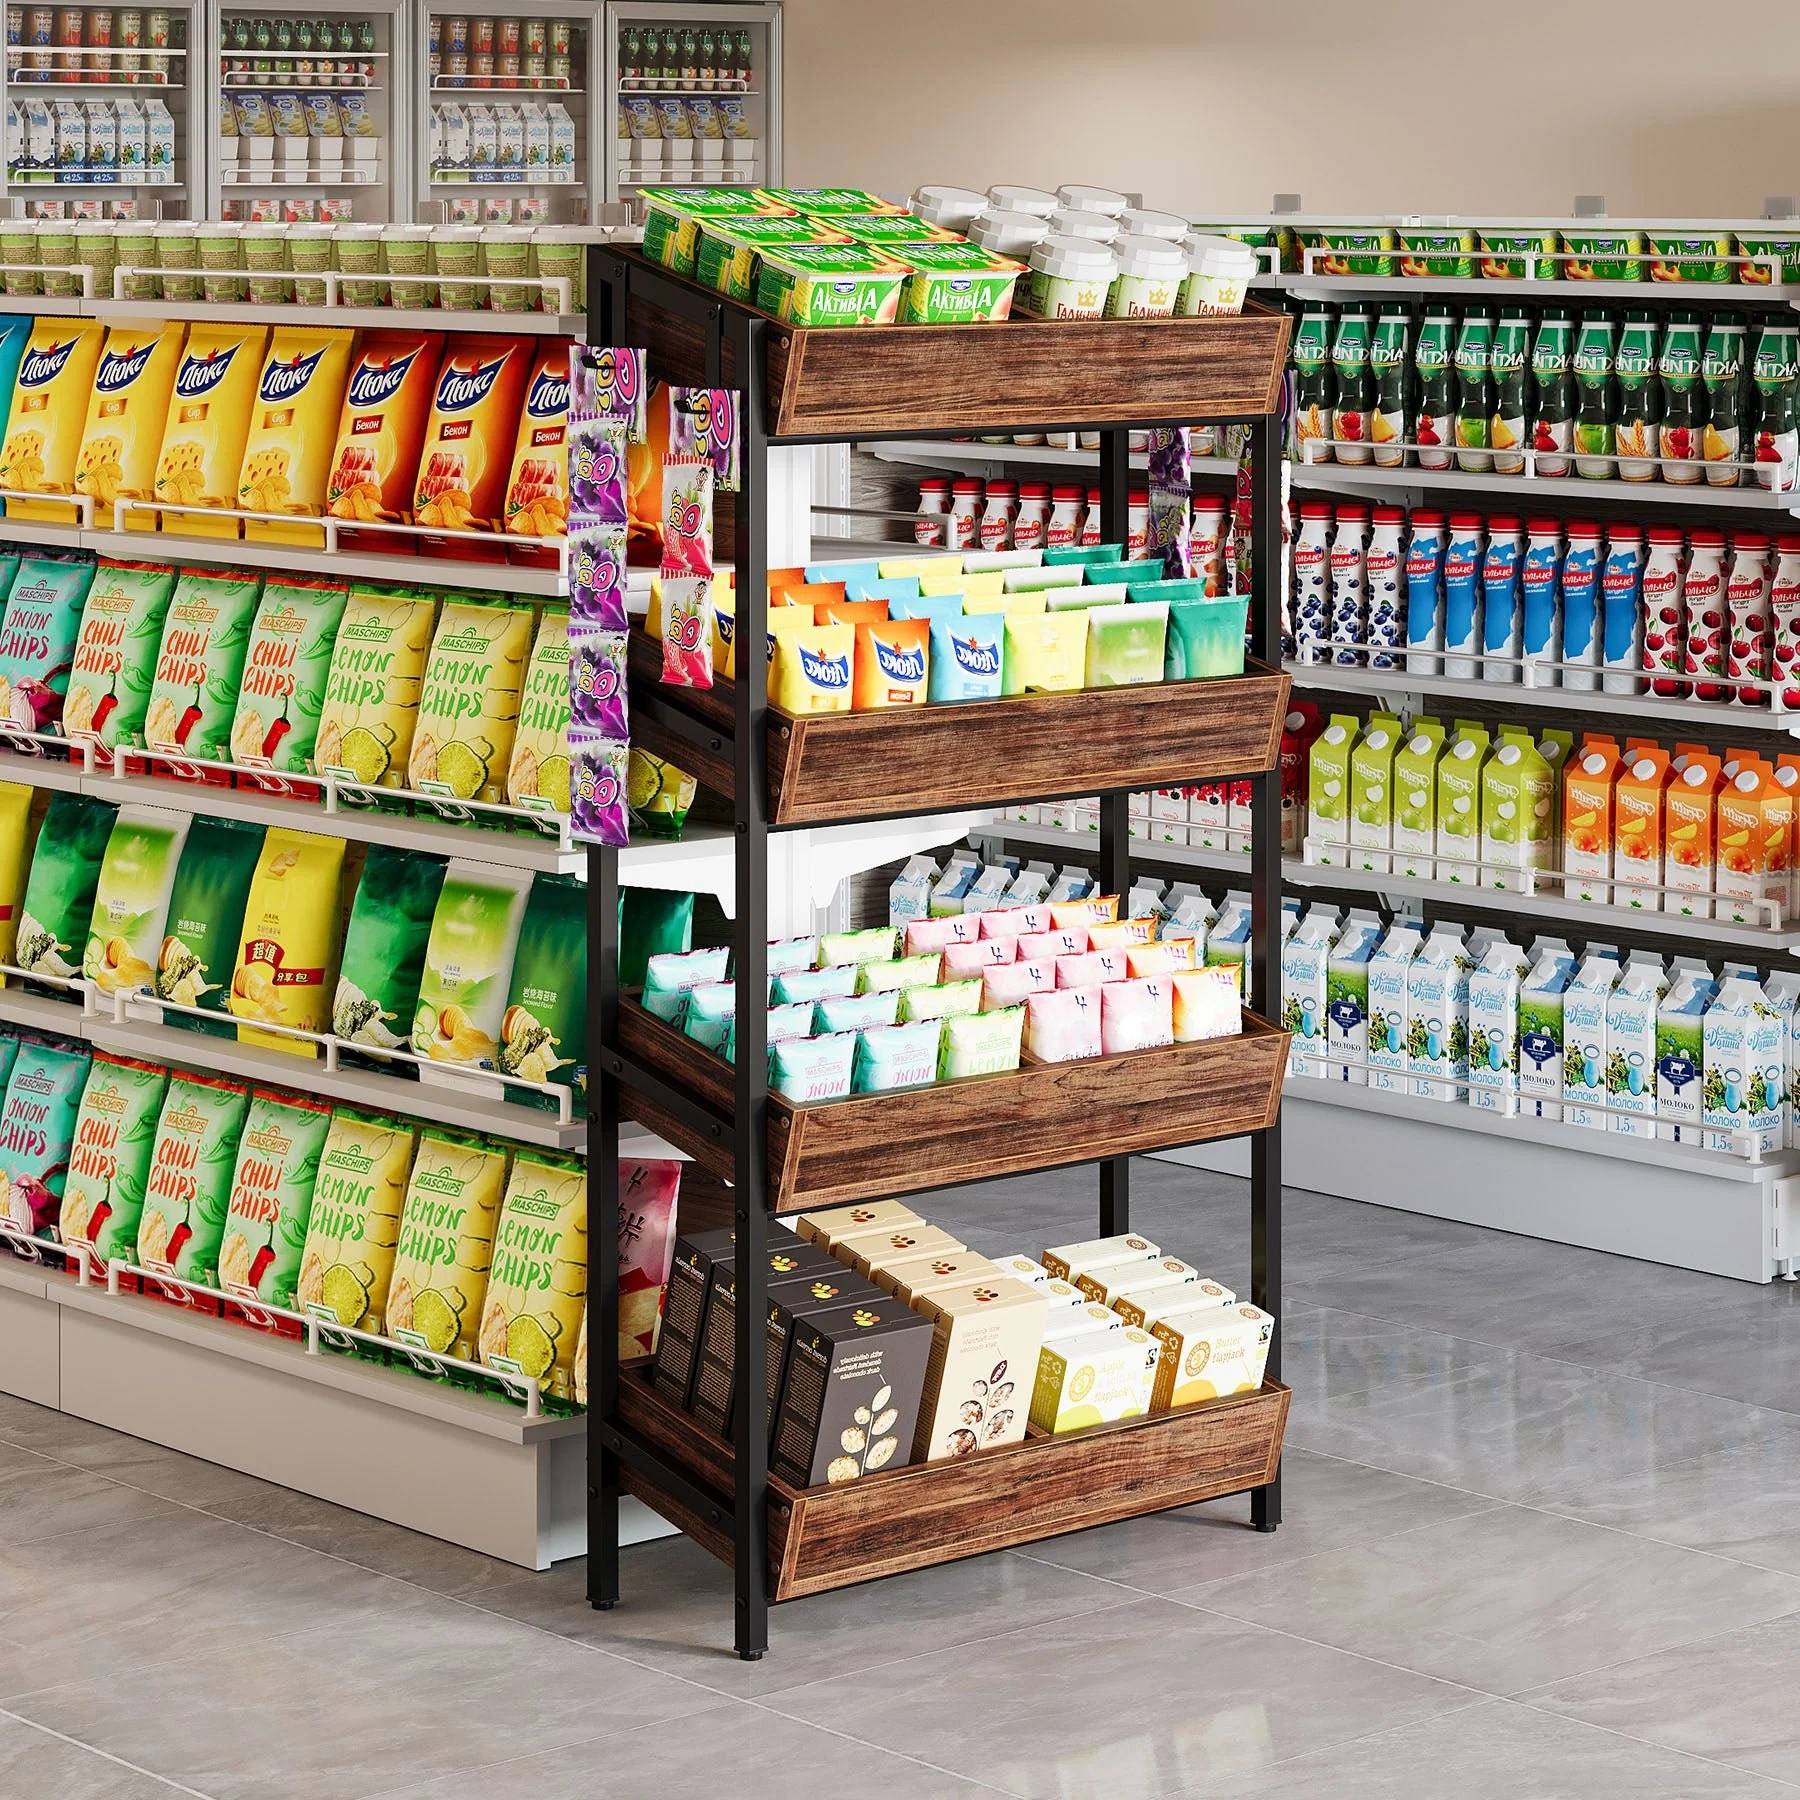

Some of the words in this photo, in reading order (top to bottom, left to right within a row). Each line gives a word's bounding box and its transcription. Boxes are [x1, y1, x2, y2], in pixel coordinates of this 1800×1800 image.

[529, 379, 570, 411] Люк
[355, 419, 379, 431] Бекон
[443, 425, 469, 437] Бекон
[535, 430, 561, 443] Бекон
[18, 589, 55, 601] MASCHIPS
[92, 598, 132, 612] MASCHIPS
[175, 608, 216, 621] MASCHIPS
[263, 617, 304, 631] MASCHIPS
[346, 627, 390, 640] MASCHIPS
[441, 638, 487, 651] MASCHIPS
[527, 669, 569, 697] LEMO
[521, 697, 571, 733] CHIP
[252, 942, 277, 963] 超值
[277, 972, 309, 982] 分享包
[1291, 1040, 1315, 1052] ОЛОКО
[1330, 1040, 1361, 1051] МОЛОКО
[894, 1050, 929, 1063] MASCHIPS
[1370, 1054, 1401, 1068] МОЛОКО
[807, 1064, 842, 1077] MASCHIPS
[1410, 1061, 1442, 1075] МОЛОКО
[17, 1077, 53, 1093] MASCHIPS
[1470, 1072, 1504, 1086] МОЛОКО
[1523, 1073, 1556, 1087] МОЛОКО
[88, 1094, 126, 1111] MASCHIPS
[1565, 1090, 1600, 1103] МОЛОКО
[1608, 1098, 1644, 1111] МОЛОКО
[1660, 1098, 1695, 1111] МОЛОКО
[165, 1113, 206, 1131] MASCHIPS
[1704, 1114, 1741, 1128] МОЛОКО
[1749, 1114, 1780, 1129] МОЛОКО
[248, 1134, 289, 1151] MASCHIPS
[329, 1154, 370, 1171] MASCHIPS
[418, 1176, 462, 1194] MASCHIPS
[512, 1198, 557, 1218] MASCHIPS
[1215, 1336, 1242, 1349] Butter
